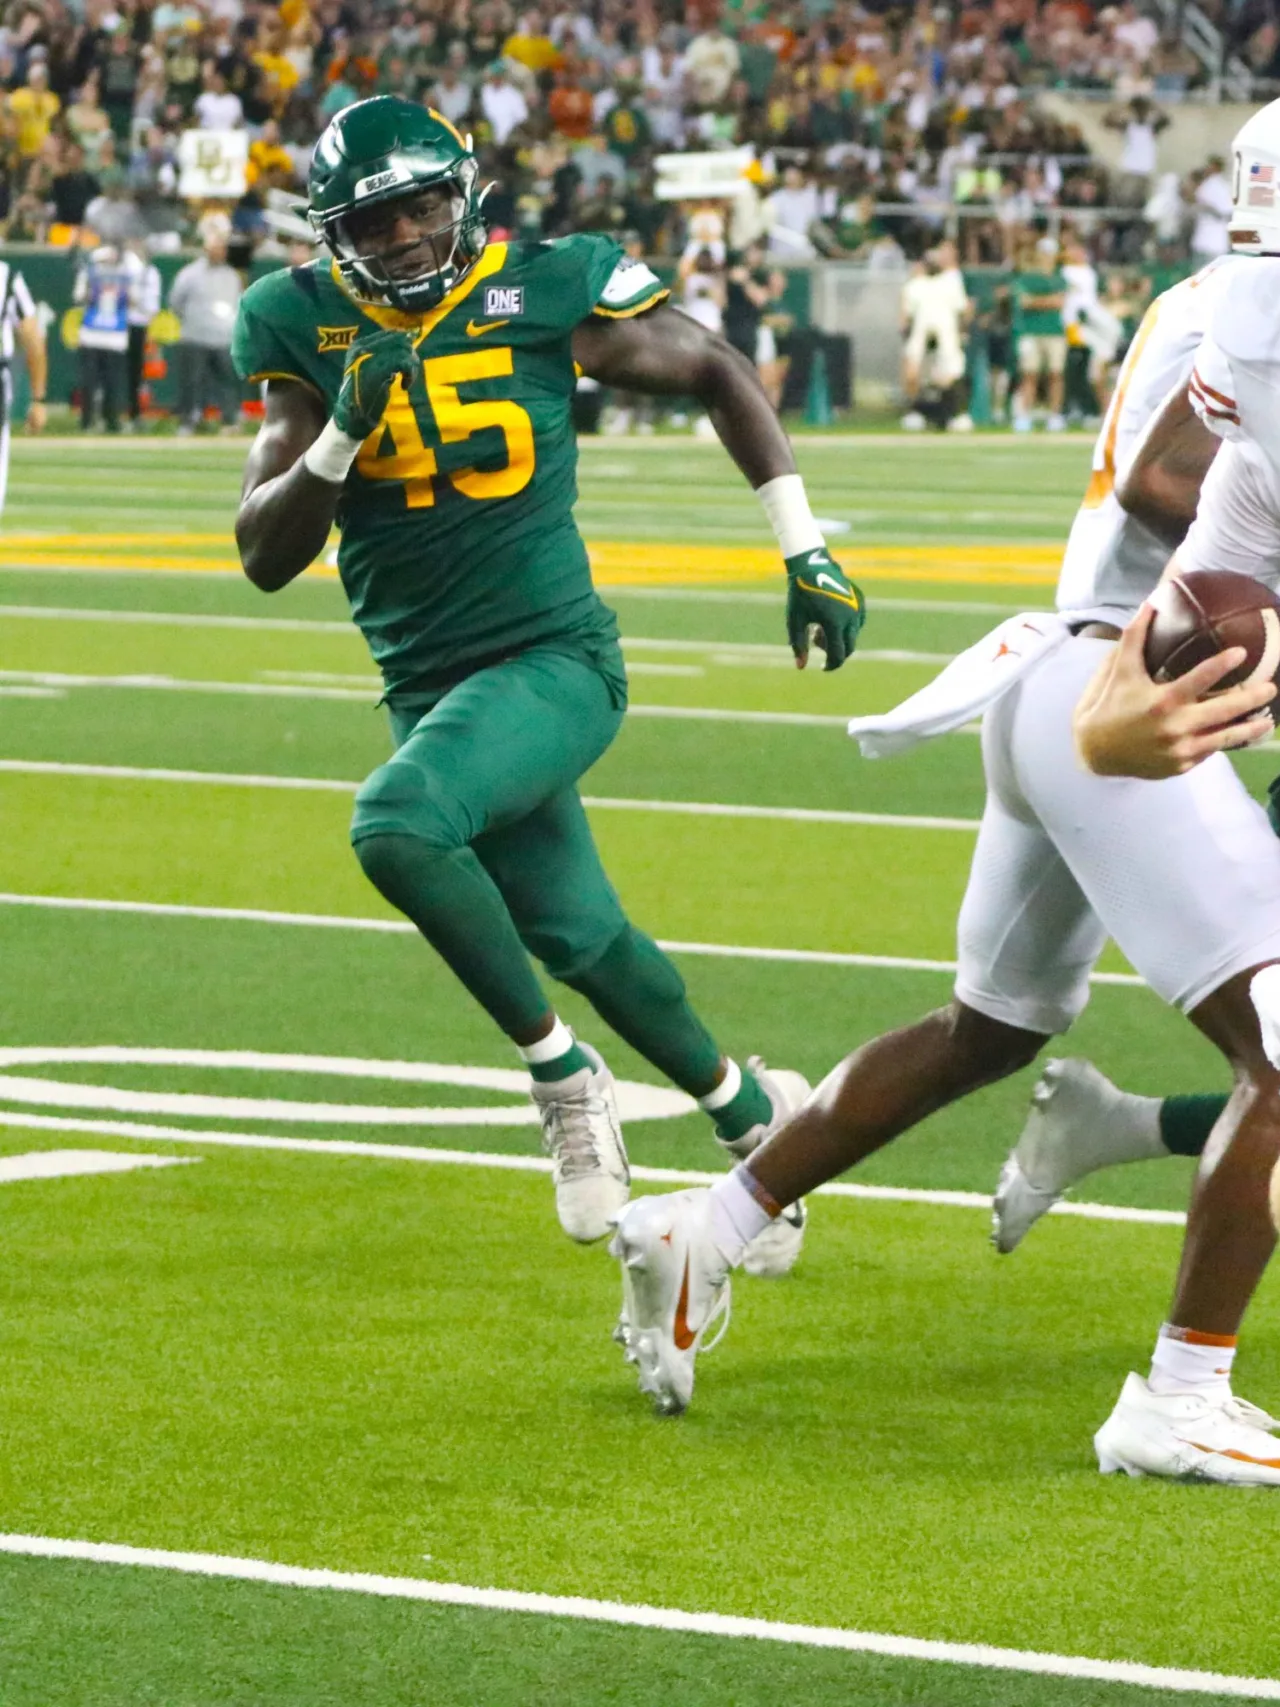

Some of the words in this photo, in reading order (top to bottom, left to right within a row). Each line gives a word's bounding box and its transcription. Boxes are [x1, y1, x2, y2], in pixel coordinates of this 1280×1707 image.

[365, 171, 398, 192] BEARS
[487, 289, 521, 309] ONE
[357, 346, 536, 509] 45
